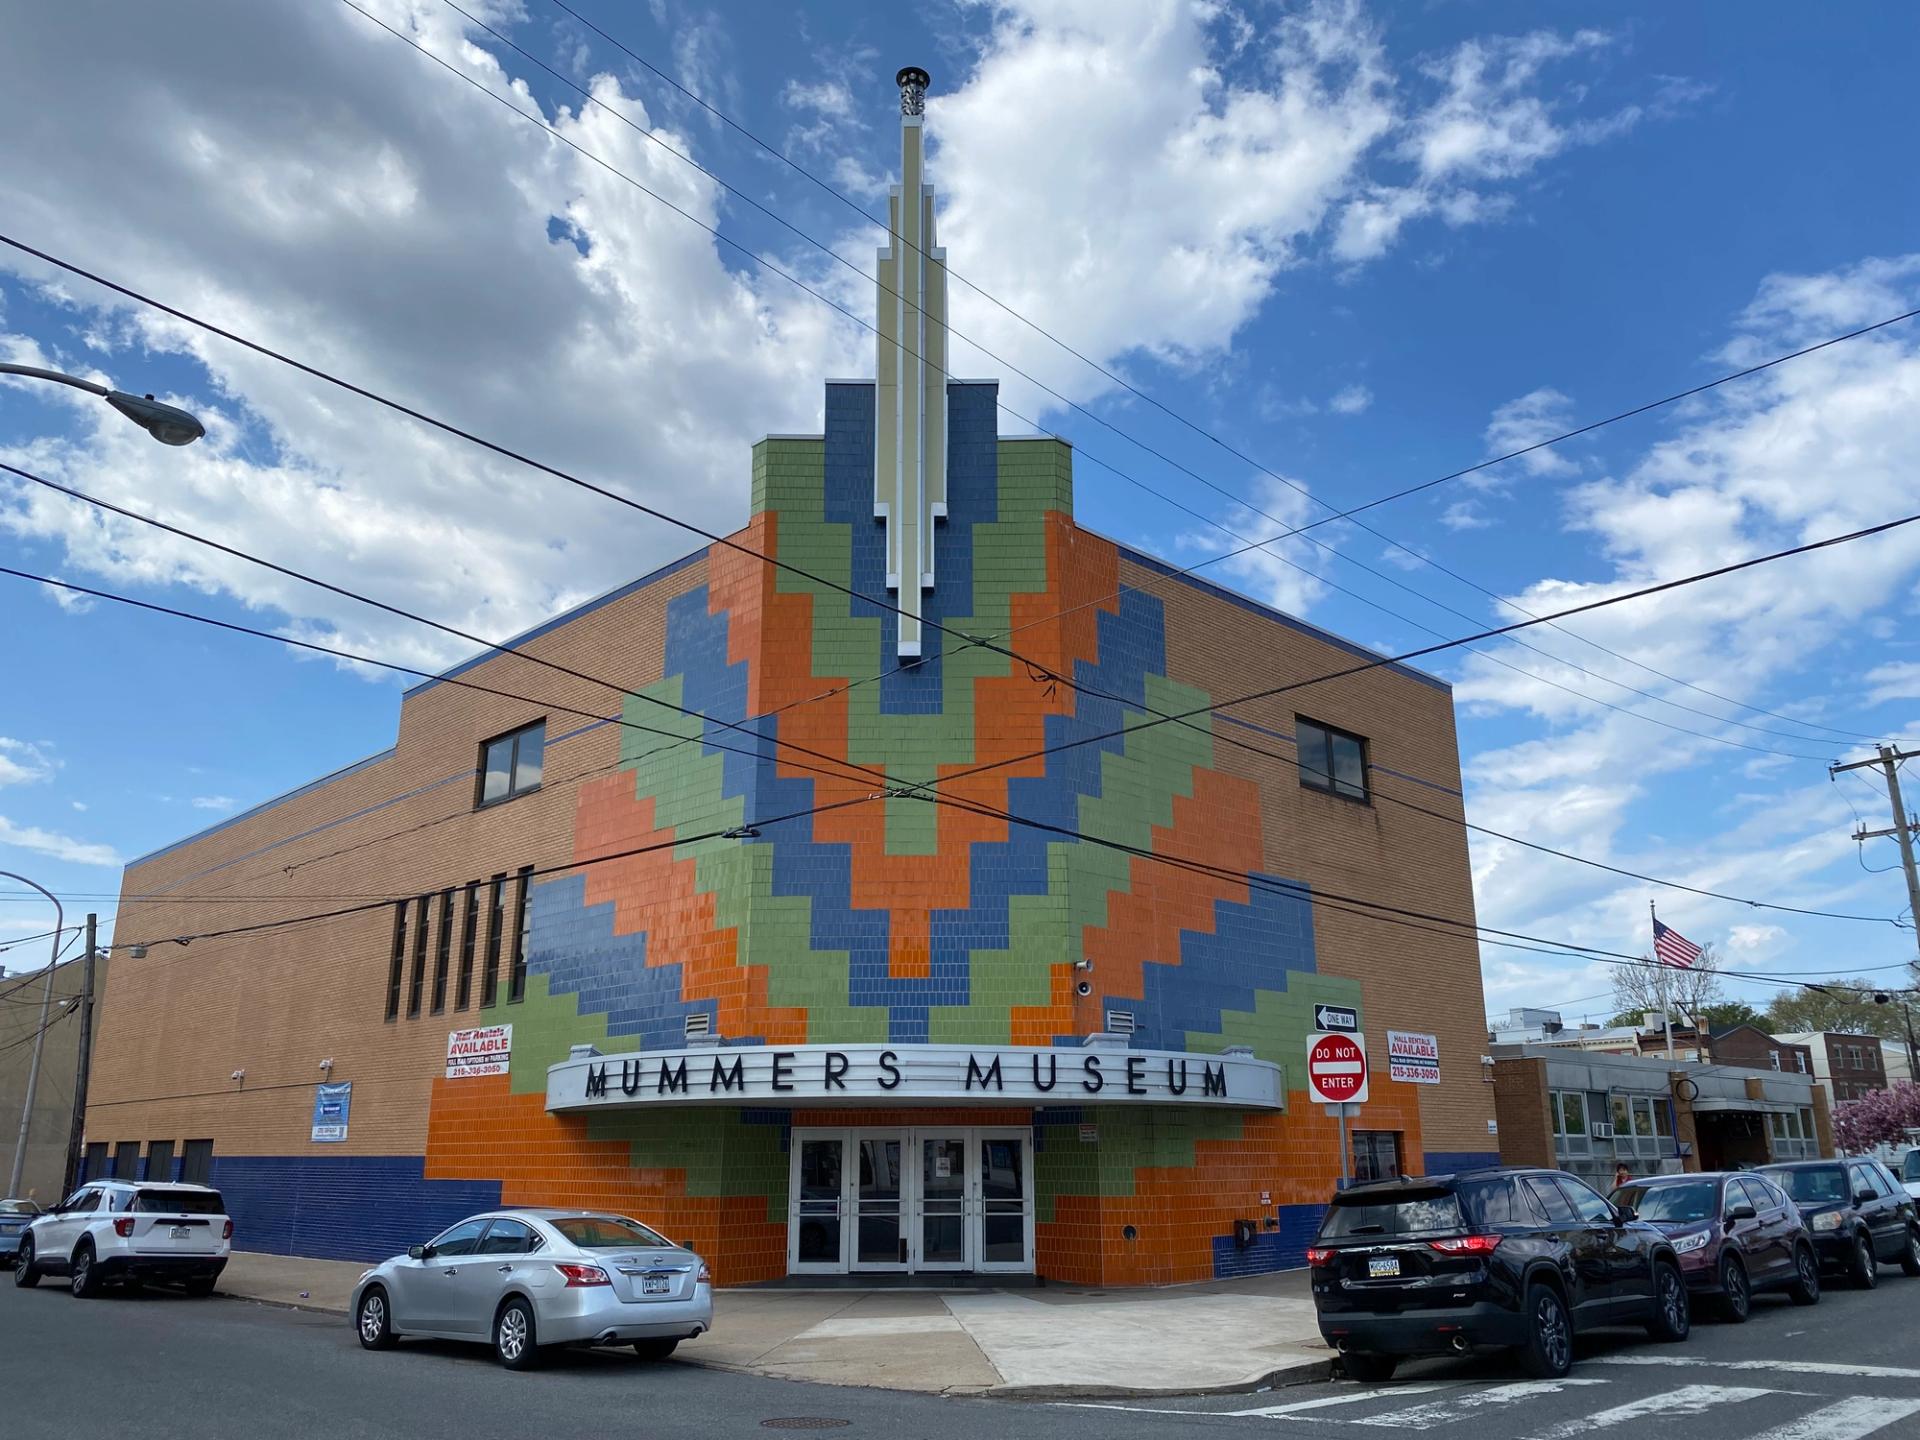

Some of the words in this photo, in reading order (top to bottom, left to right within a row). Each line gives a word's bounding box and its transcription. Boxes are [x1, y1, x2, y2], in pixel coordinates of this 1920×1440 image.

[1327, 1013, 1339, 1024] ONE
[1340, 1015, 1353, 1025] WAY
[450, 1038, 508, 1054] AVAILABLE
[1316, 1048, 1330, 1059] DO
[1335, 1047, 1355, 1058] NOT
[1391, 1042, 1436, 1057] AVAILABLE
[585, 1051, 901, 1098] MUMMERS
[965, 1053, 1228, 1097] MUSEUM
[1392, 1066, 1438, 1080] 215-336-3050
[1322, 1077, 1354, 1089] ENTER
